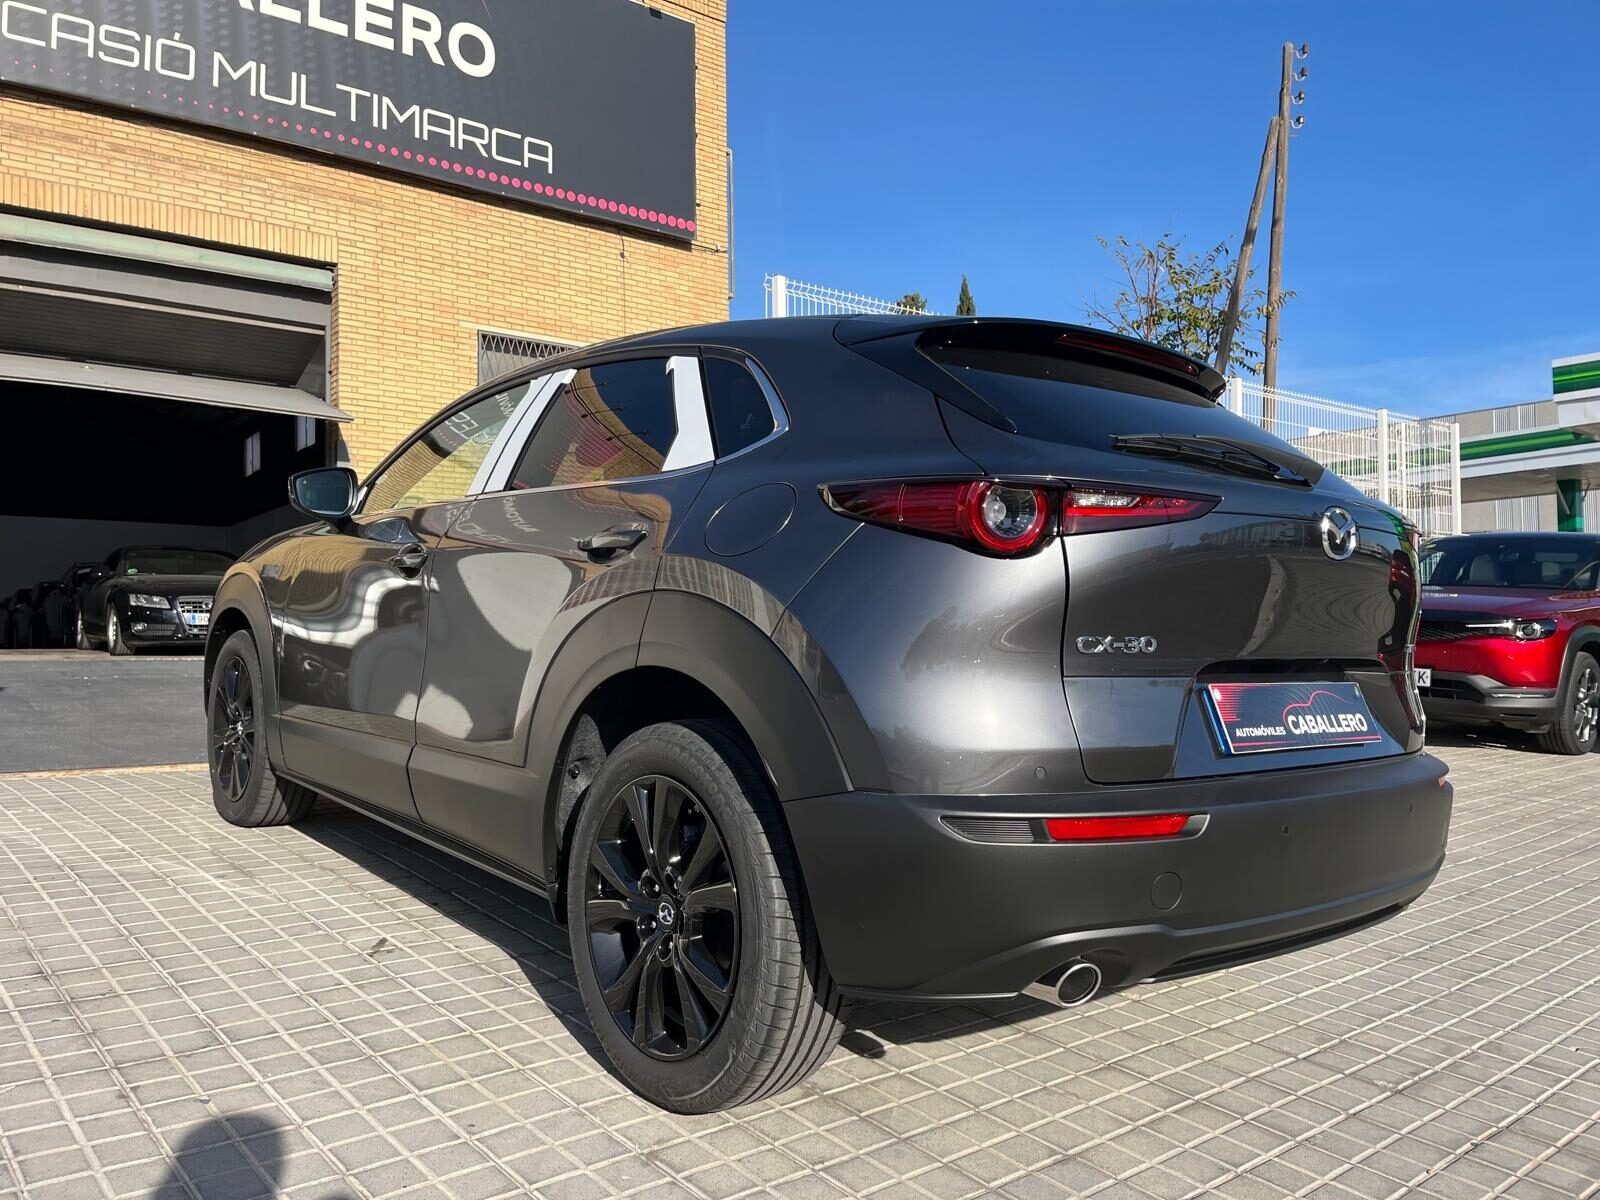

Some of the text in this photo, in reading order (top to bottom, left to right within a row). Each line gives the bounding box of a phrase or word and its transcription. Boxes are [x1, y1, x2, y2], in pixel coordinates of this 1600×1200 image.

[212, 51, 553, 174] MULTIMARCA
[1076, 635, 1158, 654] CX-30
[1235, 713, 1368, 738] AUTOMÓVILES CABALLERO
